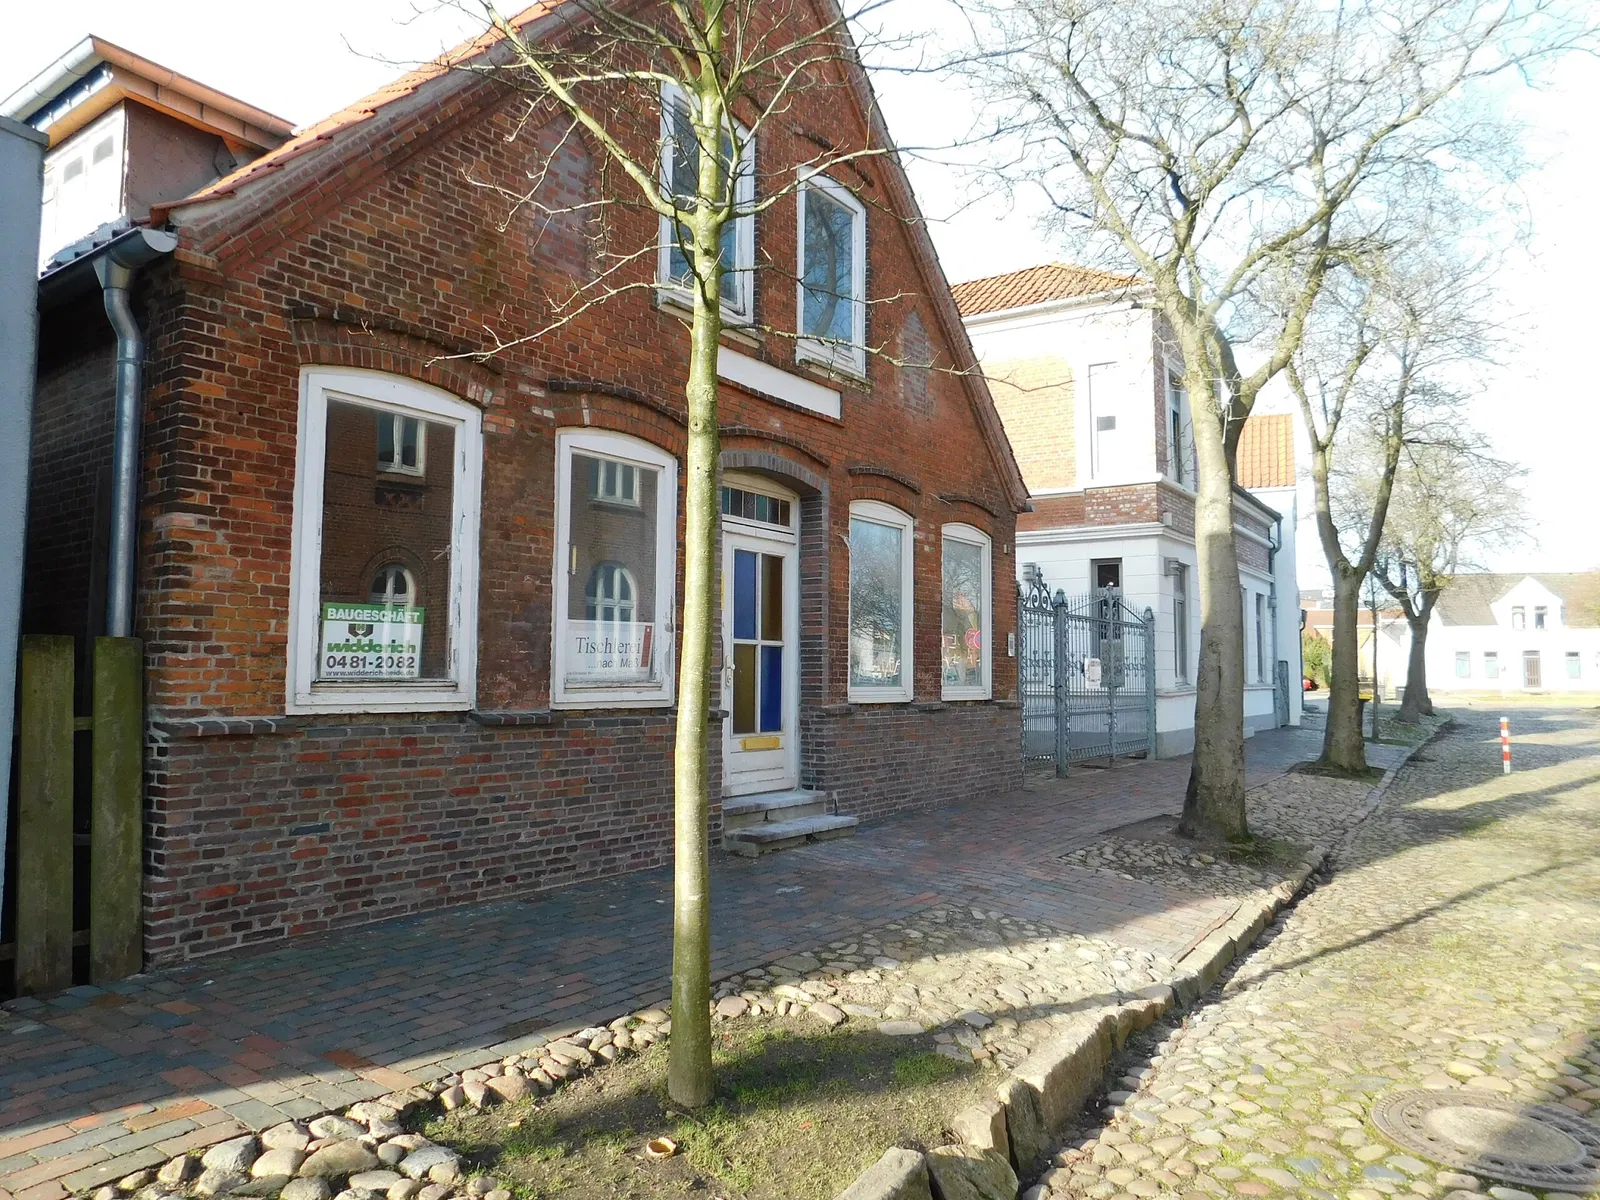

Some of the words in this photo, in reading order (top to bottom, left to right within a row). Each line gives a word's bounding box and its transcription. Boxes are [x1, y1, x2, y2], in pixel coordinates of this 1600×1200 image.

[327, 608, 420, 622] BAUGESCHÄFT
[327, 638, 416, 653] widderich
[576, 637, 640, 654] Tischlerei
[326, 655, 415, 669] 0481-2082
[588, 658, 617, 669] ...nac
[620, 658, 639, 668] Maß
